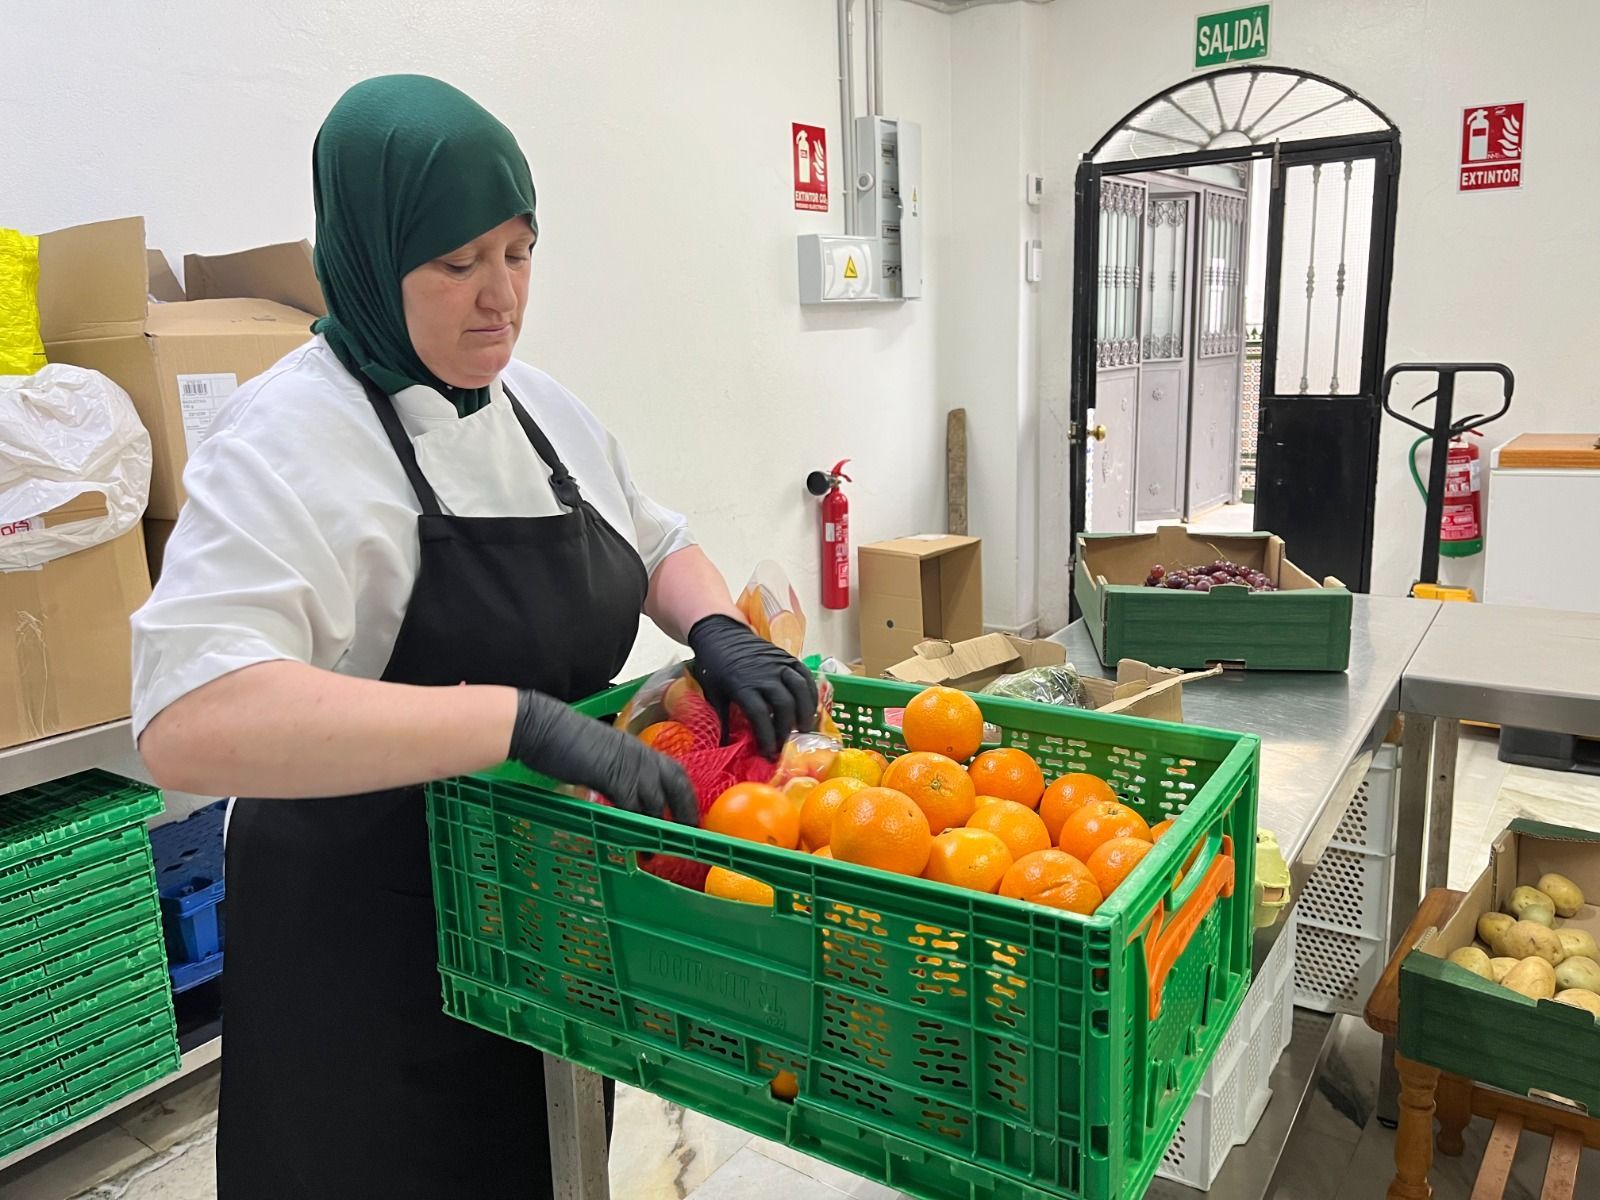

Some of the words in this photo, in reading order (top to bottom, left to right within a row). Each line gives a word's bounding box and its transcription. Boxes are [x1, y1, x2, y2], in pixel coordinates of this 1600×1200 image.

[1198, 16, 1265, 57] SALIDA
[1461, 168, 1519, 186] EXTINTOR
[796, 190, 819, 203] EXTINTOR
